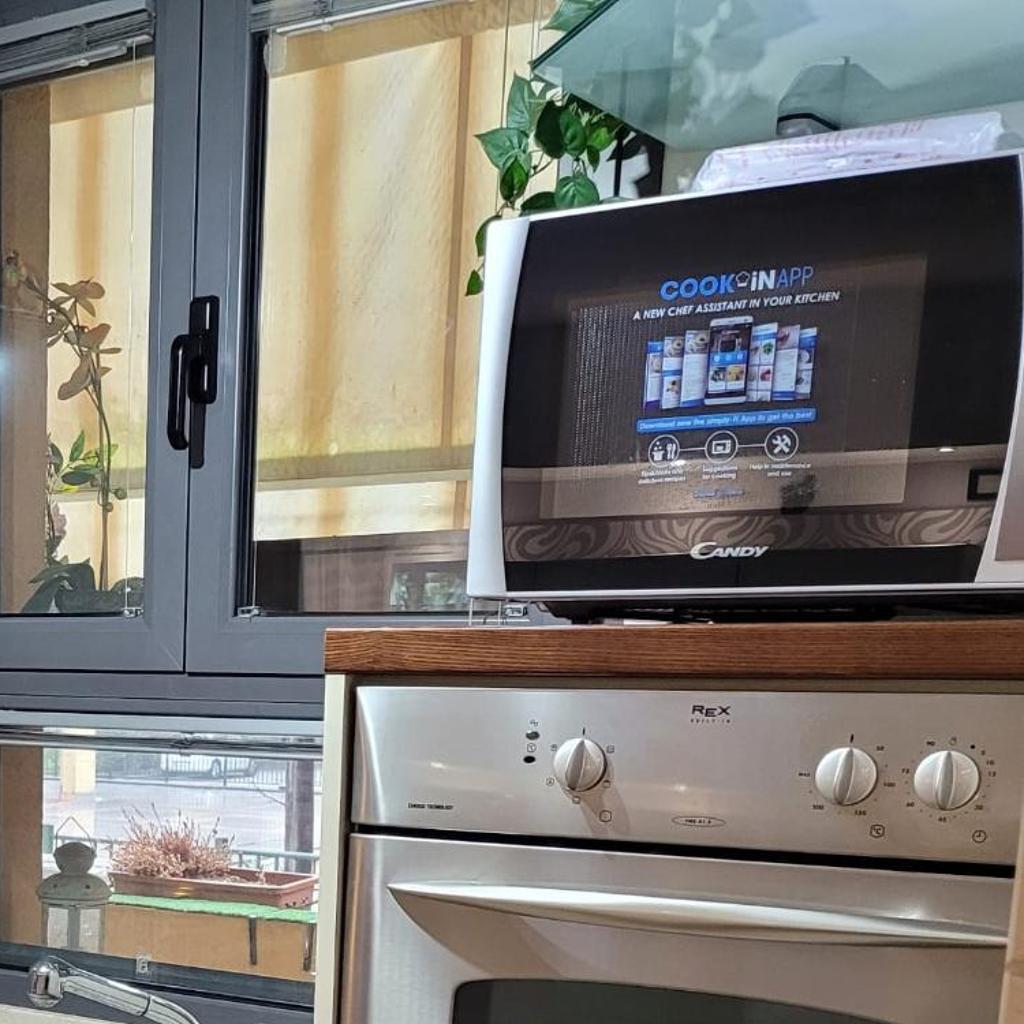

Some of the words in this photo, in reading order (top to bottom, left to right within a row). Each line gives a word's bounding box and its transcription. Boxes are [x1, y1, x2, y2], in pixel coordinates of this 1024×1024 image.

[660, 273, 736, 300] COOK
[633, 311, 641, 321] A
[643, 308, 666, 319] NEW
[667, 305, 694, 317] CHEF
[695, 300, 748, 314] ASSISTANT
[749, 299, 761, 309] IN
[763, 295, 792, 307] YOUR
[795, 291, 841, 304] KITCHEN
[690, 541, 770, 560] CANDY
[691, 704, 732, 718] REX
